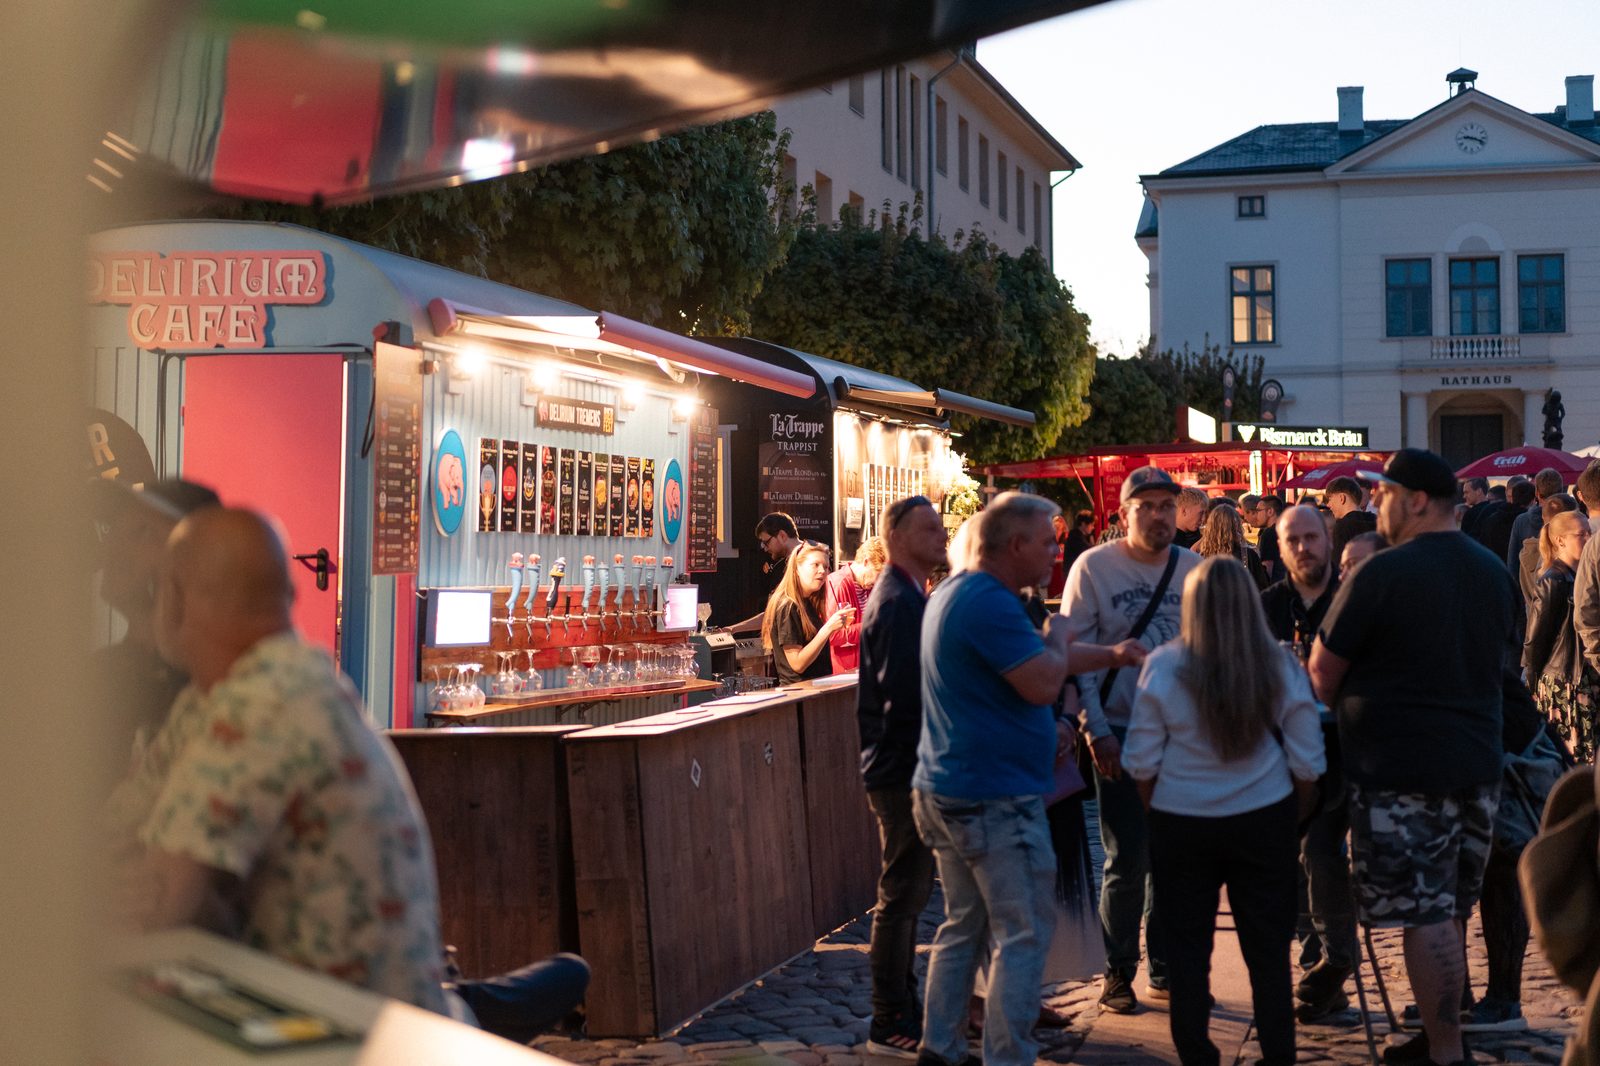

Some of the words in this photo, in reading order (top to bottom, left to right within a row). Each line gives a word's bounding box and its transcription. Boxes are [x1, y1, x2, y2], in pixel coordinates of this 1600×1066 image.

[1441, 375, 1512, 385] RATHAUS
[549, 403, 575, 423] DELIRIUM
[576, 407, 601, 427] TREMENS
[1260, 427, 1328, 446] Bismarck
[777, 441, 818, 452] TRAPPIST
